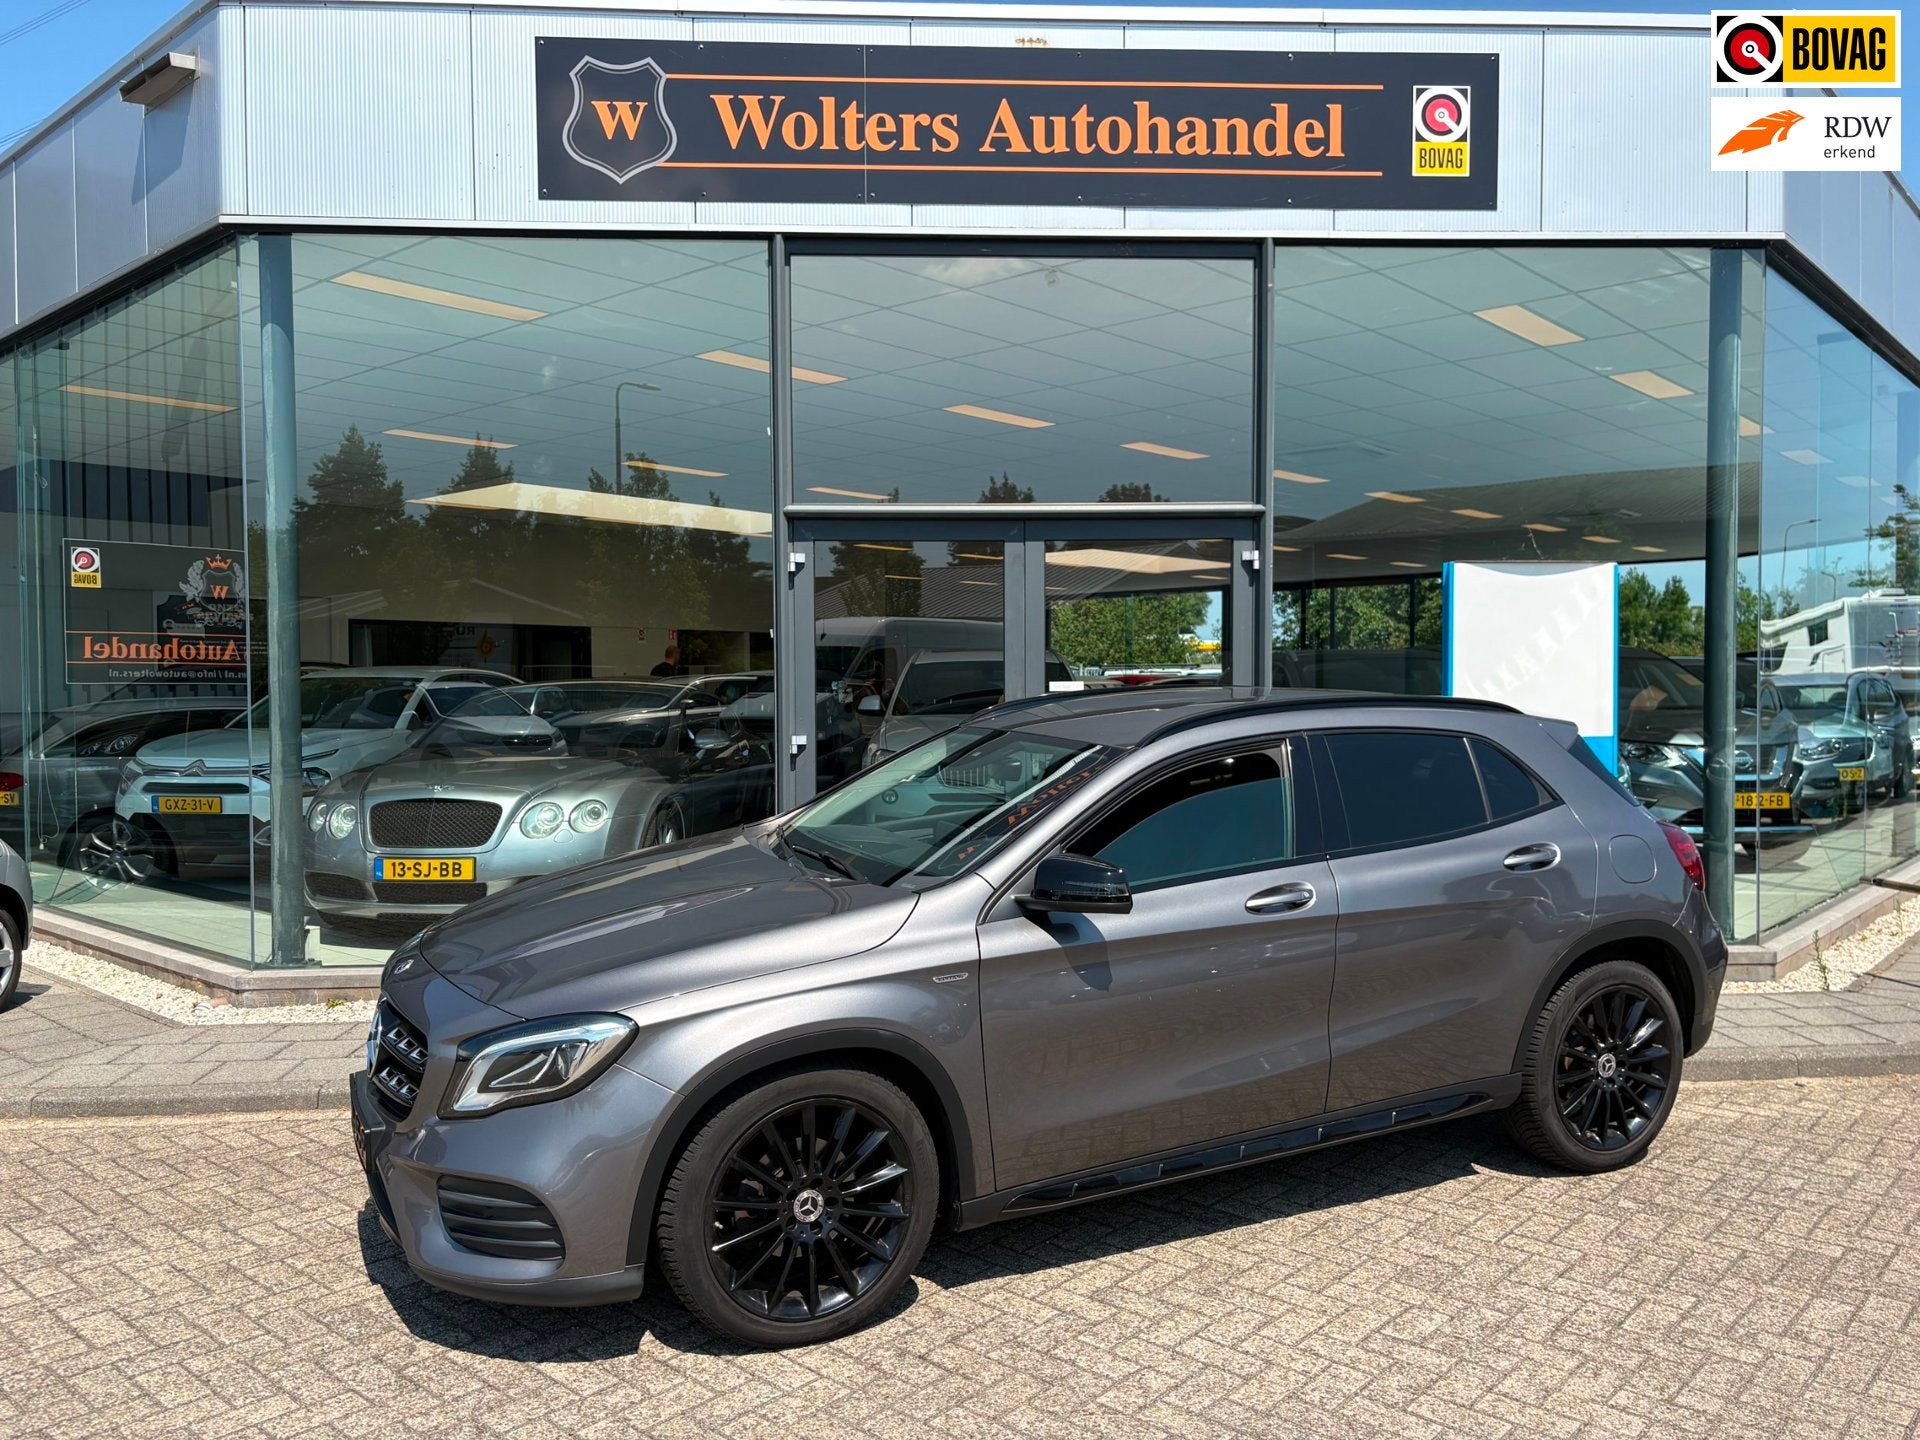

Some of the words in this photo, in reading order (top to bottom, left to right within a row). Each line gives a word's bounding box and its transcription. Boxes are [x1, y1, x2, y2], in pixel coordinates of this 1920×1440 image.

[591, 101, 648, 141] W
[710, 94, 960, 153] Wolters
[979, 98, 1346, 157] Autohandel
[1419, 148, 1463, 169] BOVAG
[165, 798, 214, 811] GXZ-31-V
[391, 861, 462, 878] 13-SJ-BB
